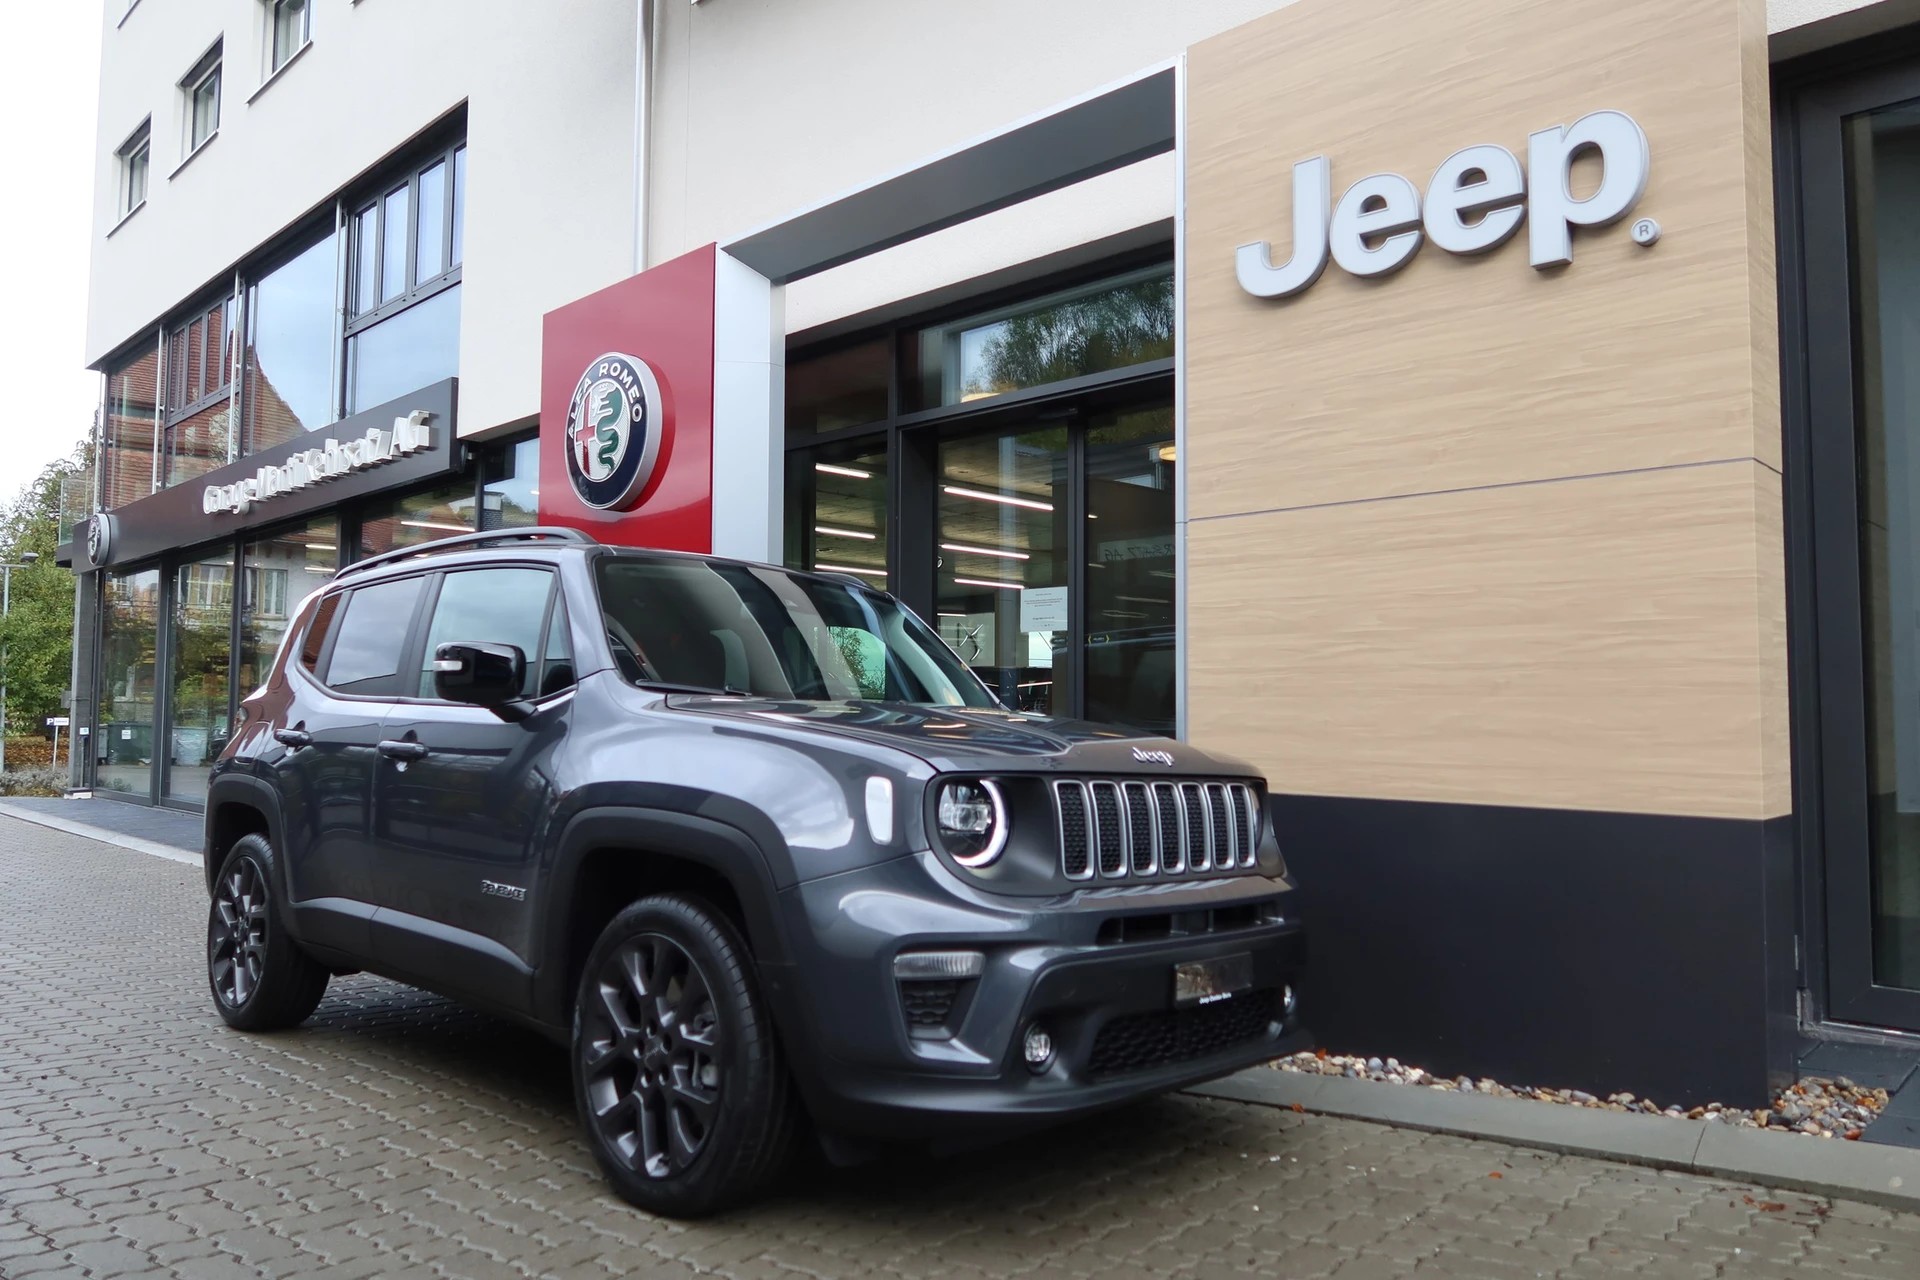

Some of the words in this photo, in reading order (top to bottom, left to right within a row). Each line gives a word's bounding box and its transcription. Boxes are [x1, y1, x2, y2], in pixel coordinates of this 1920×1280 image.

[1235, 109, 1650, 299] Jeep
[568, 379, 592, 439] ALFA
[598, 362, 643, 423] ROMEO
[203, 477, 258, 515] Garage
[390, 409, 430, 456] AG
